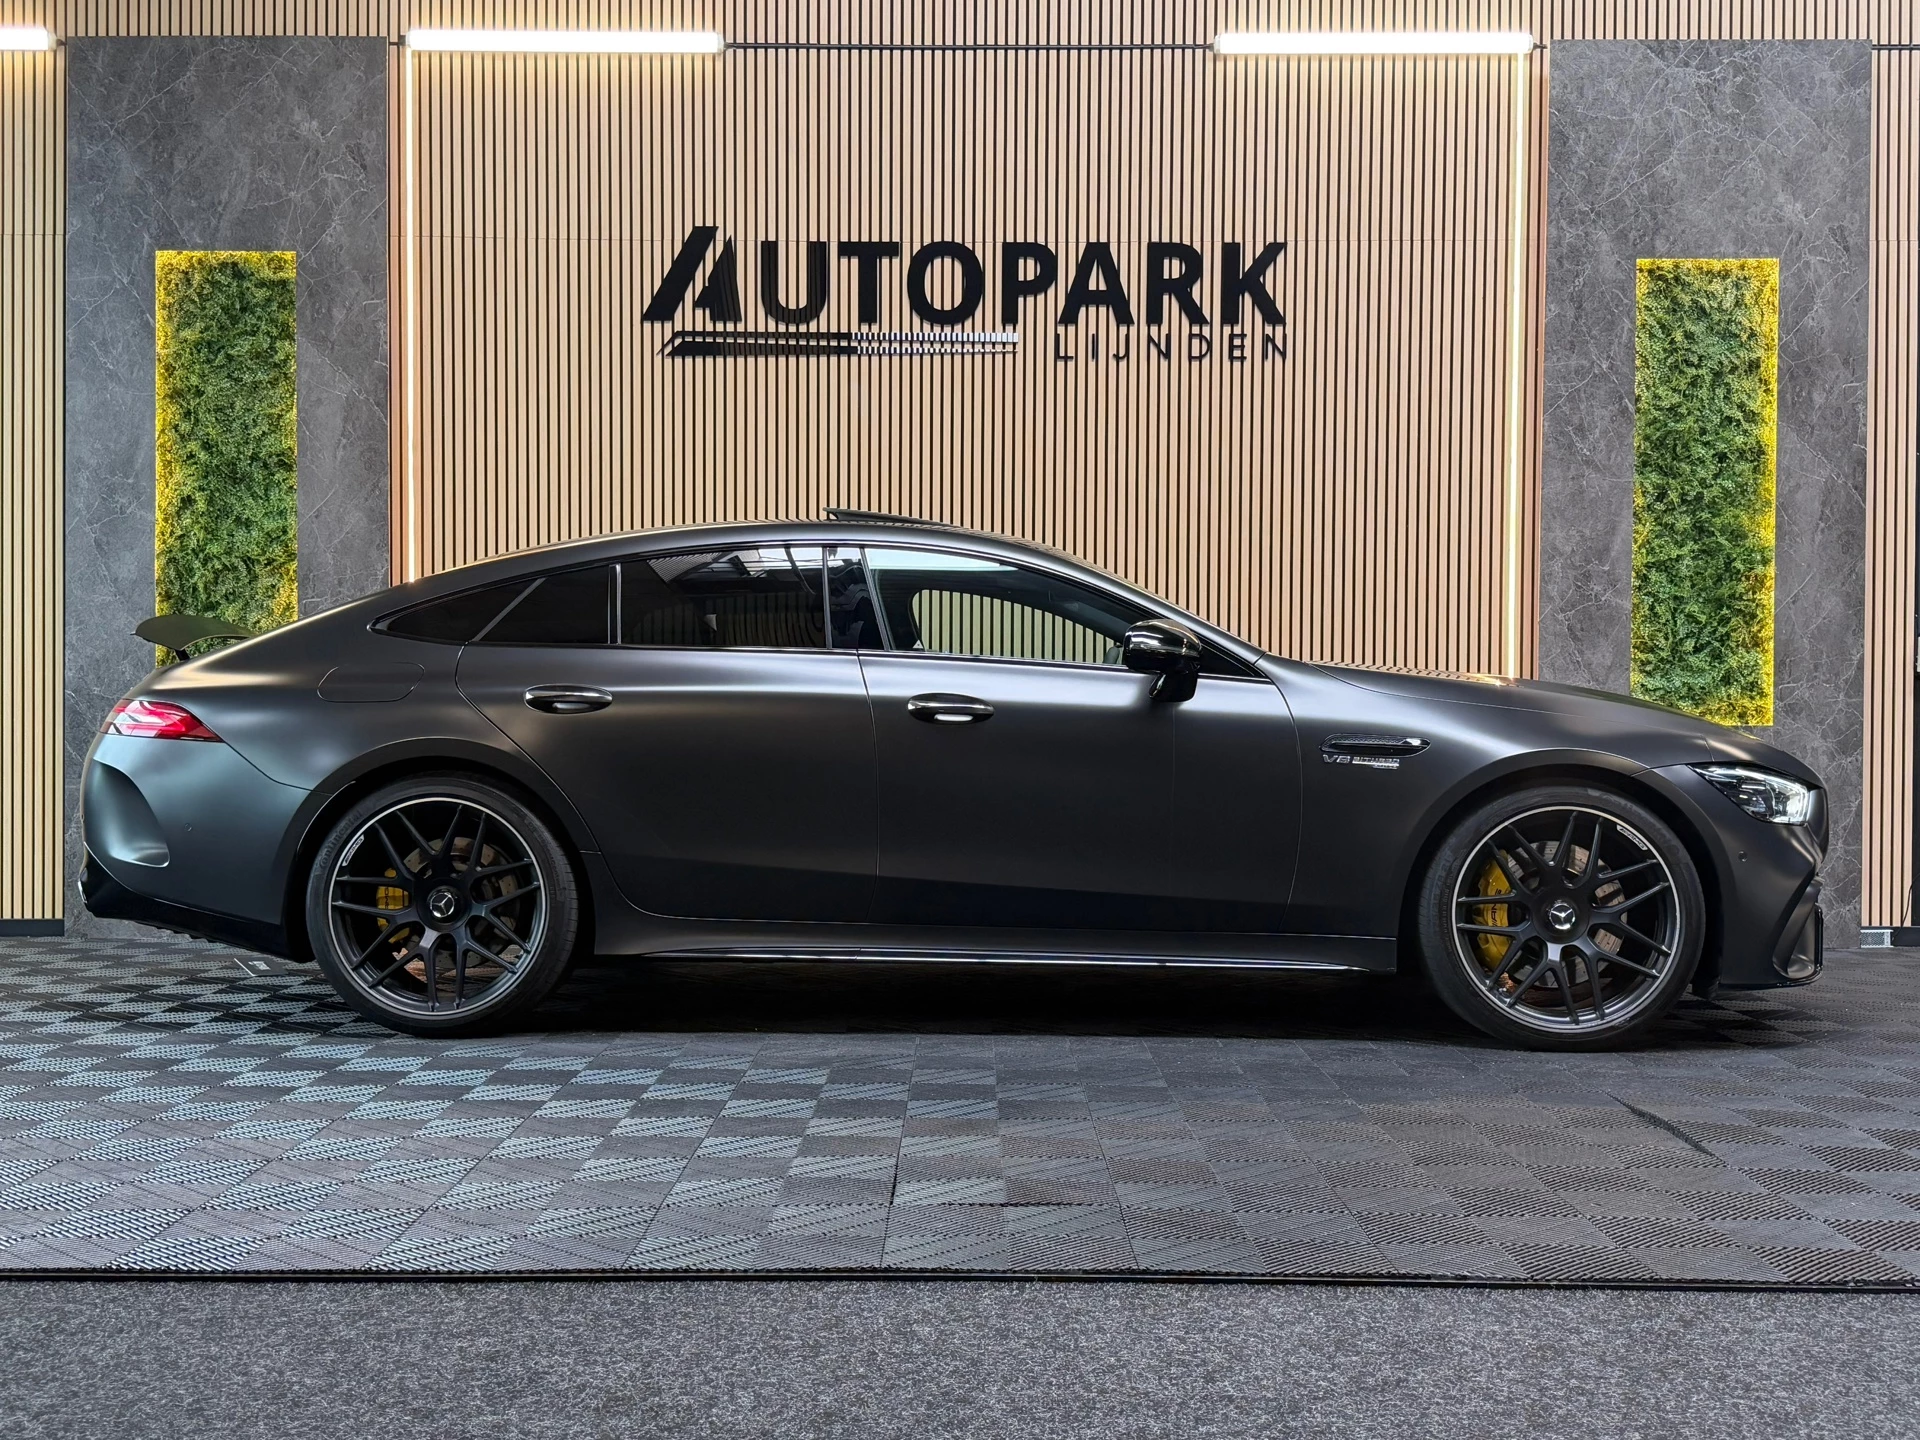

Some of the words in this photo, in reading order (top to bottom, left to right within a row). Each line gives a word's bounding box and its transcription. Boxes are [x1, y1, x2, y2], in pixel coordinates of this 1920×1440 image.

[641, 225, 1287, 326] AUTOPARK
[1055, 333, 1288, 360] LIJNDEN
[1322, 754, 1351, 764] V8
